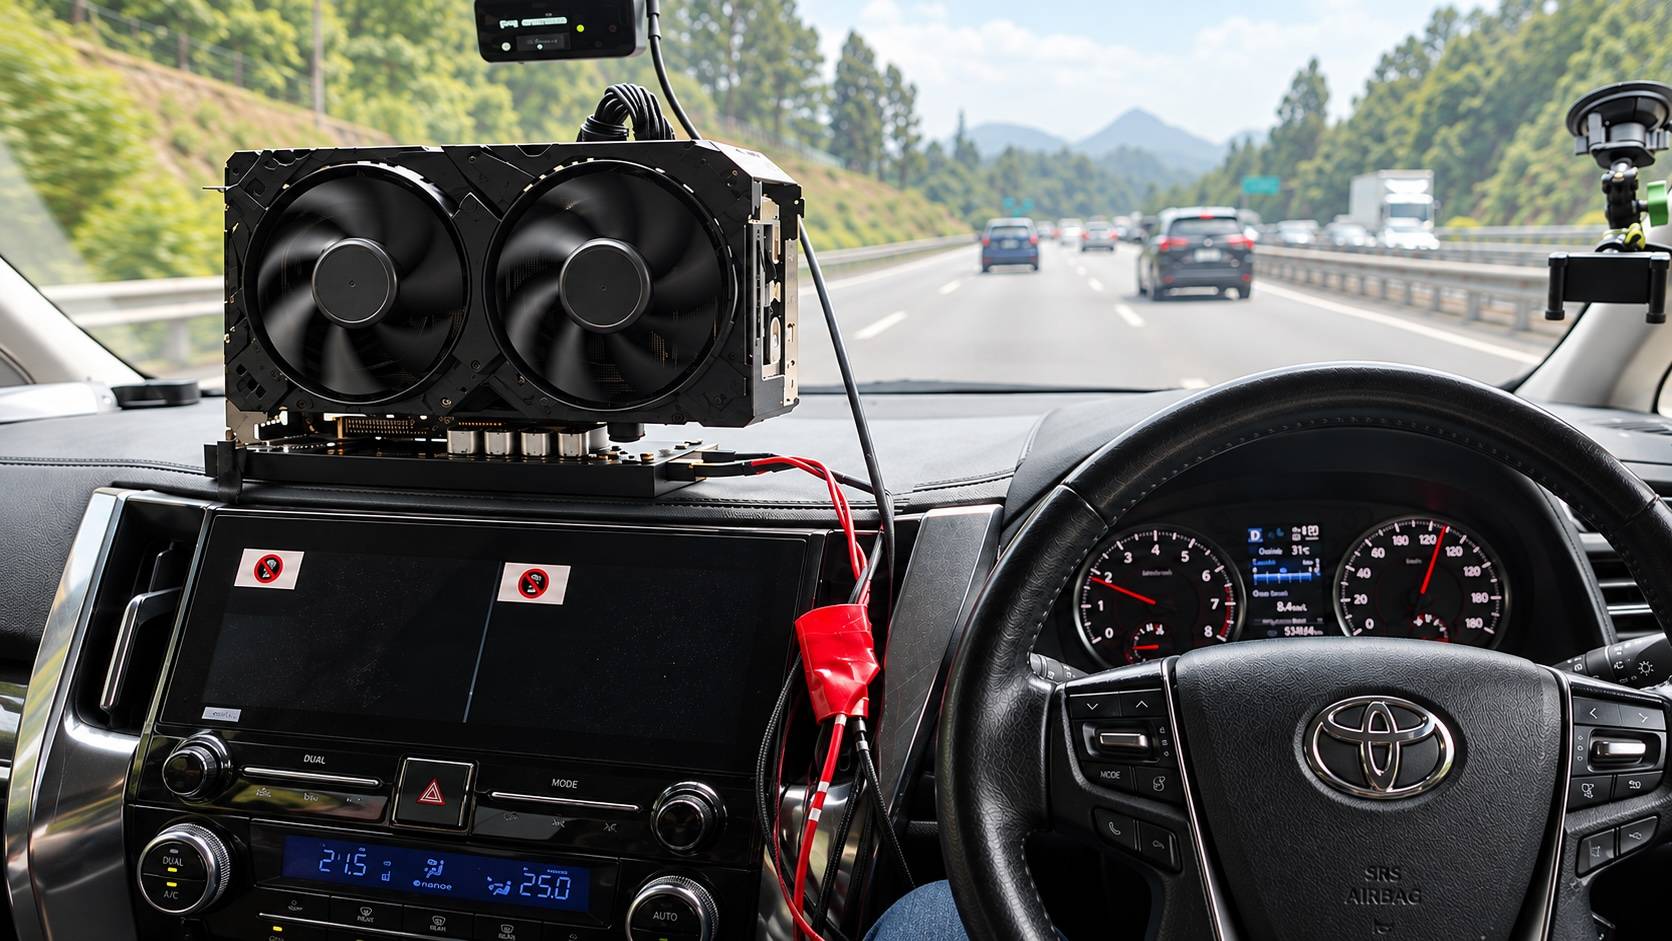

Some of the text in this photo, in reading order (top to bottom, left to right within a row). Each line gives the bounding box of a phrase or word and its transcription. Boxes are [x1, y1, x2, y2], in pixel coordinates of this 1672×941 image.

[1250, 530, 1261, 541] D
[1151, 544, 1160, 556] 4
[1181, 550, 1190, 562] 5
[1124, 552, 1133, 564] 3
[1104, 572, 1113, 584] 2
[1202, 570, 1211, 582] 6
[1356, 568, 1371, 579] 40
[1097, 600, 1104, 611] 1
[1210, 598, 1220, 610] 7
[1354, 594, 1368, 605] 20
[1365, 618, 1375, 630] 0
[1105, 627, 1114, 639] 0
[1204, 625, 1213, 637] 8
[303, 754, 326, 765] DUAL
[552, 778, 578, 789] MODE
[163, 856, 183, 867] DUAL
[1364, 867, 1401, 883] SRS
[519, 873, 571, 900] 25.0
[163, 890, 179, 900] A/C
[1344, 889, 1422, 906] AIRBAG
[653, 911, 678, 922] AUTO
